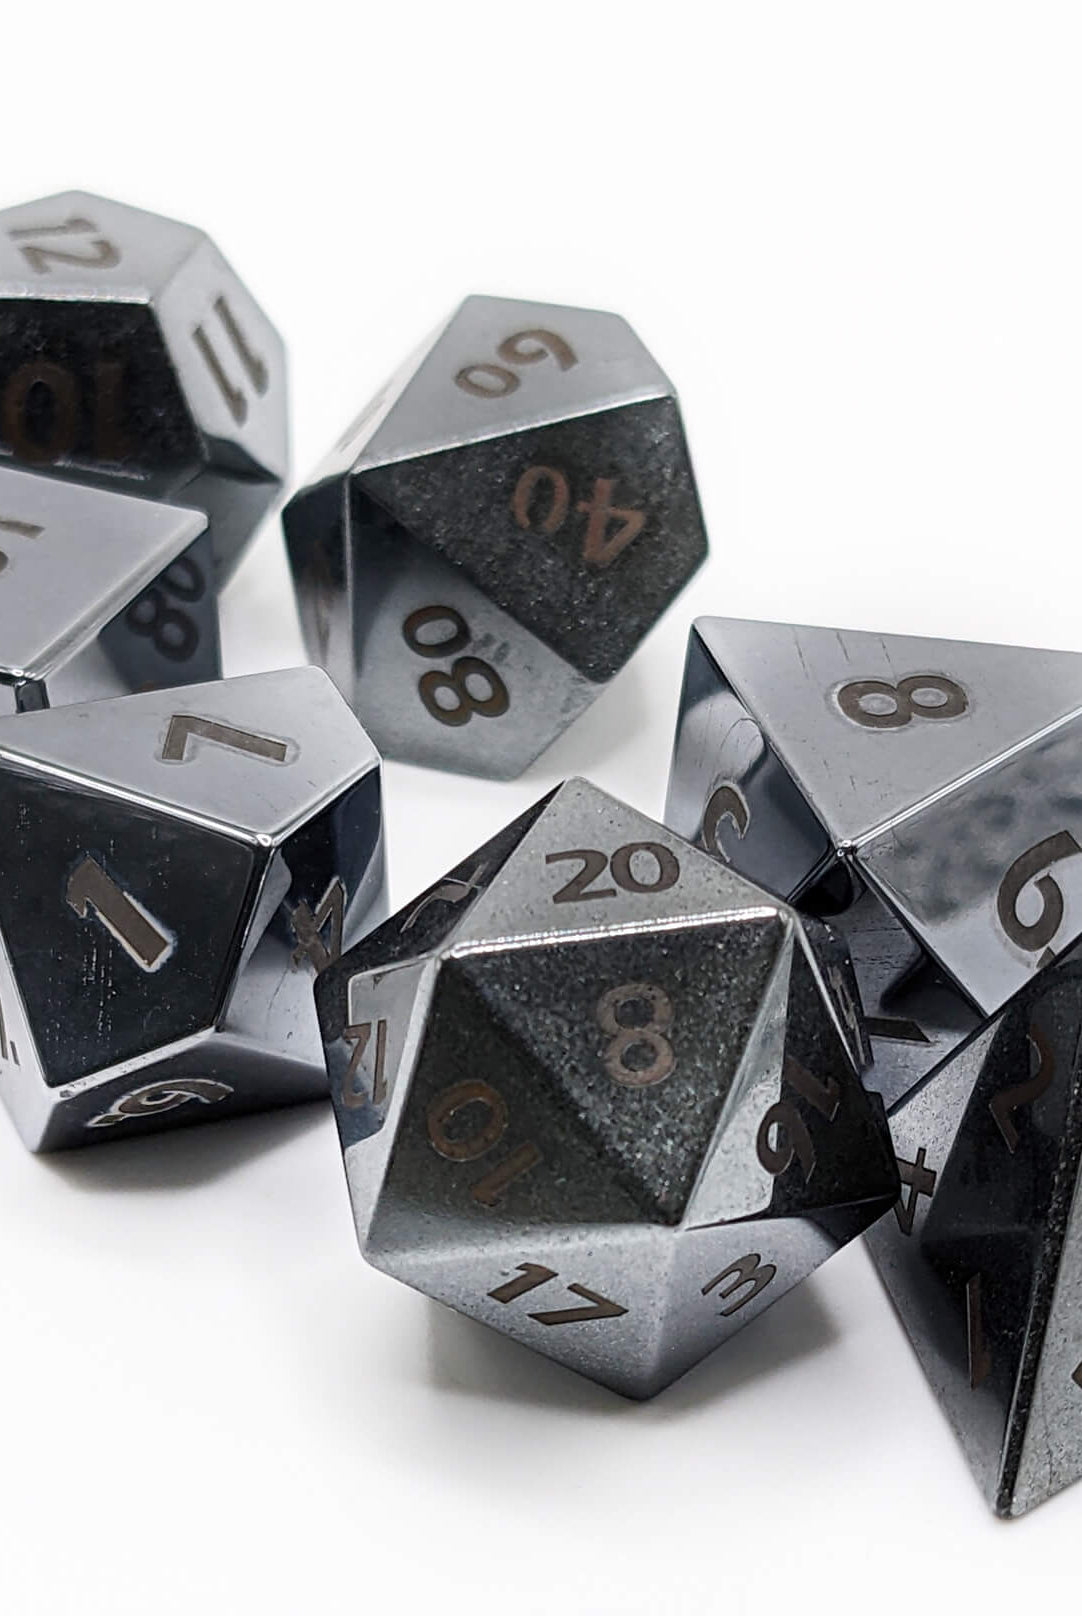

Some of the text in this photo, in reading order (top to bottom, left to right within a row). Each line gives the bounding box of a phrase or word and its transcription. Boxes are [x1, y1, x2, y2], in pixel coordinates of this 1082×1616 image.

[8, 217, 122, 275] 12
[191, 295, 270, 428] 11
[454, 329, 578, 399] 60
[514, 466, 646, 568] 40
[403, 605, 510, 726] 80
[836, 674, 969, 728] 8
[161, 714, 288, 762] 7
[66, 855, 172, 971] 1
[545, 841, 681, 904] 20
[998, 830, 1082, 967] 6
[597, 983, 677, 1088] 8
[427, 1079, 545, 1207] 10
[893, 1148, 938, 1236] 4
[486, 1262, 630, 1326] 17
[701, 1253, 777, 1317] 3
